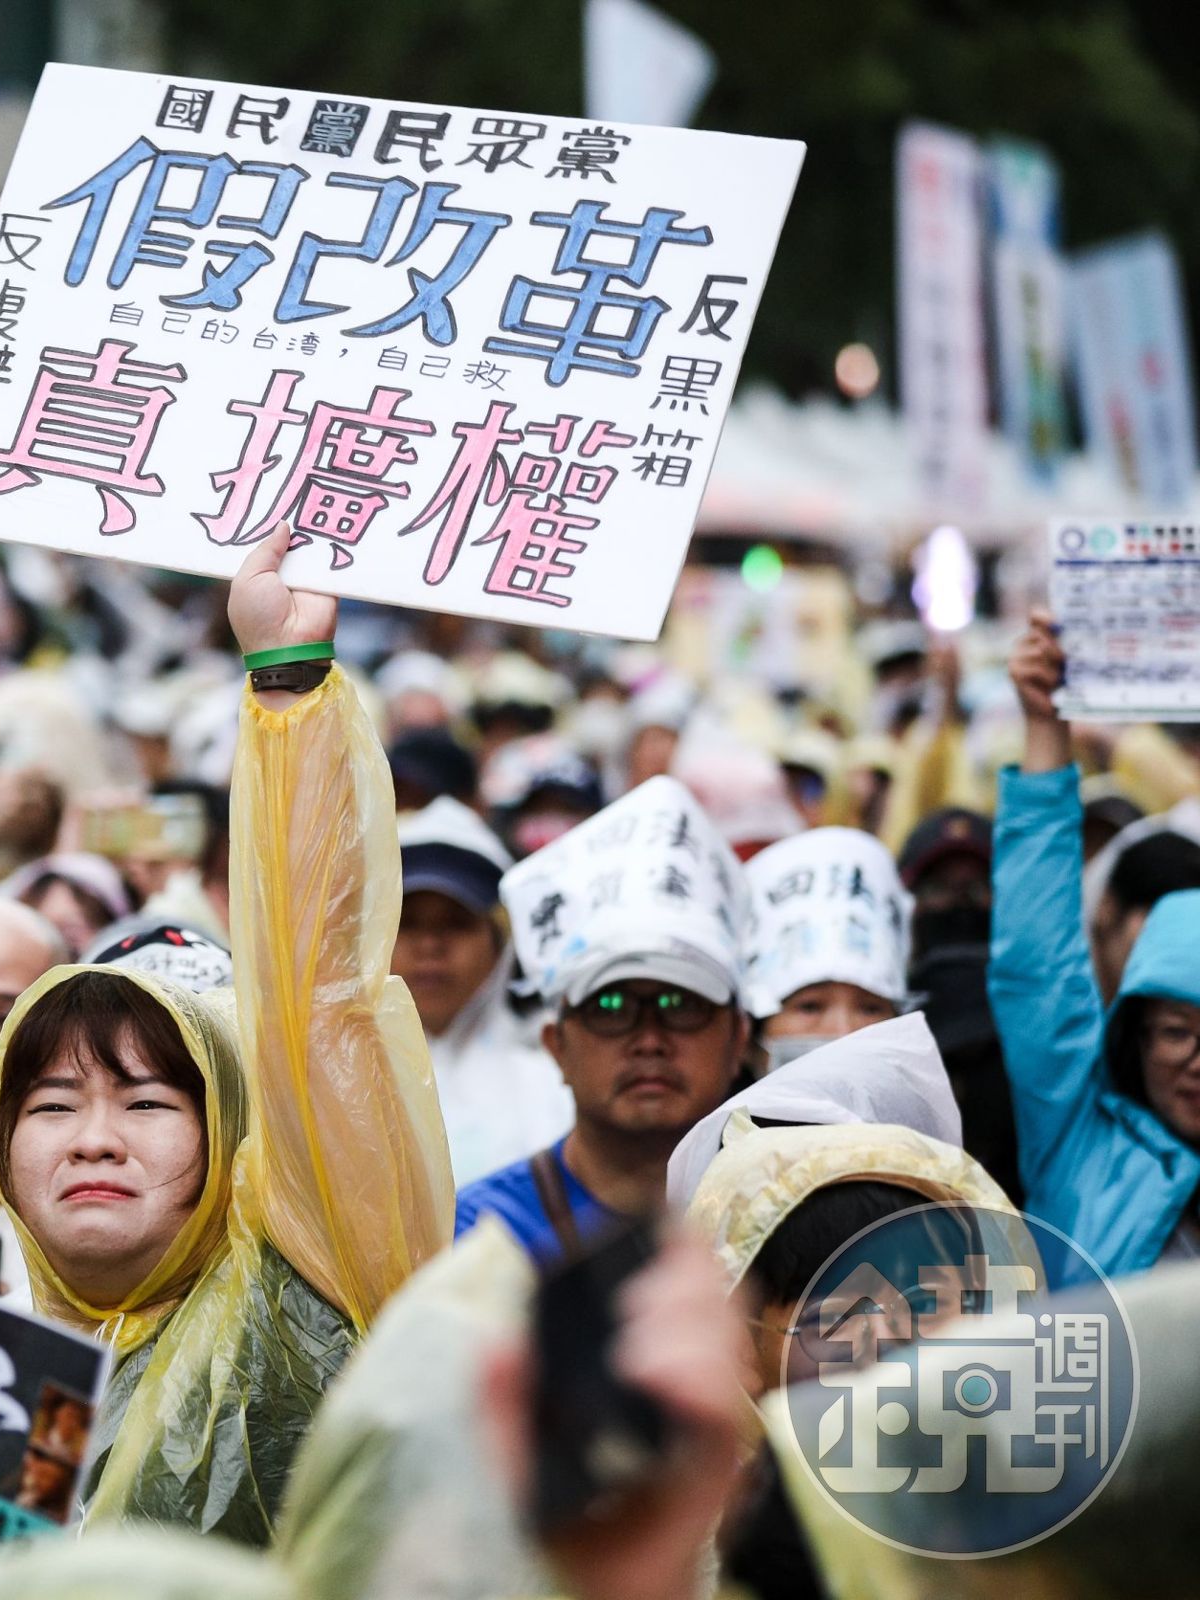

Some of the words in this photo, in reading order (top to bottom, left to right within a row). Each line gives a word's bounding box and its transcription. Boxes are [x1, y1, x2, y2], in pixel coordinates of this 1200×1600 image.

[155, 84, 631, 184] 國民黨民眾黨
[40, 135, 714, 388] 假改革
[631, 274, 749, 489] 反黑箱
